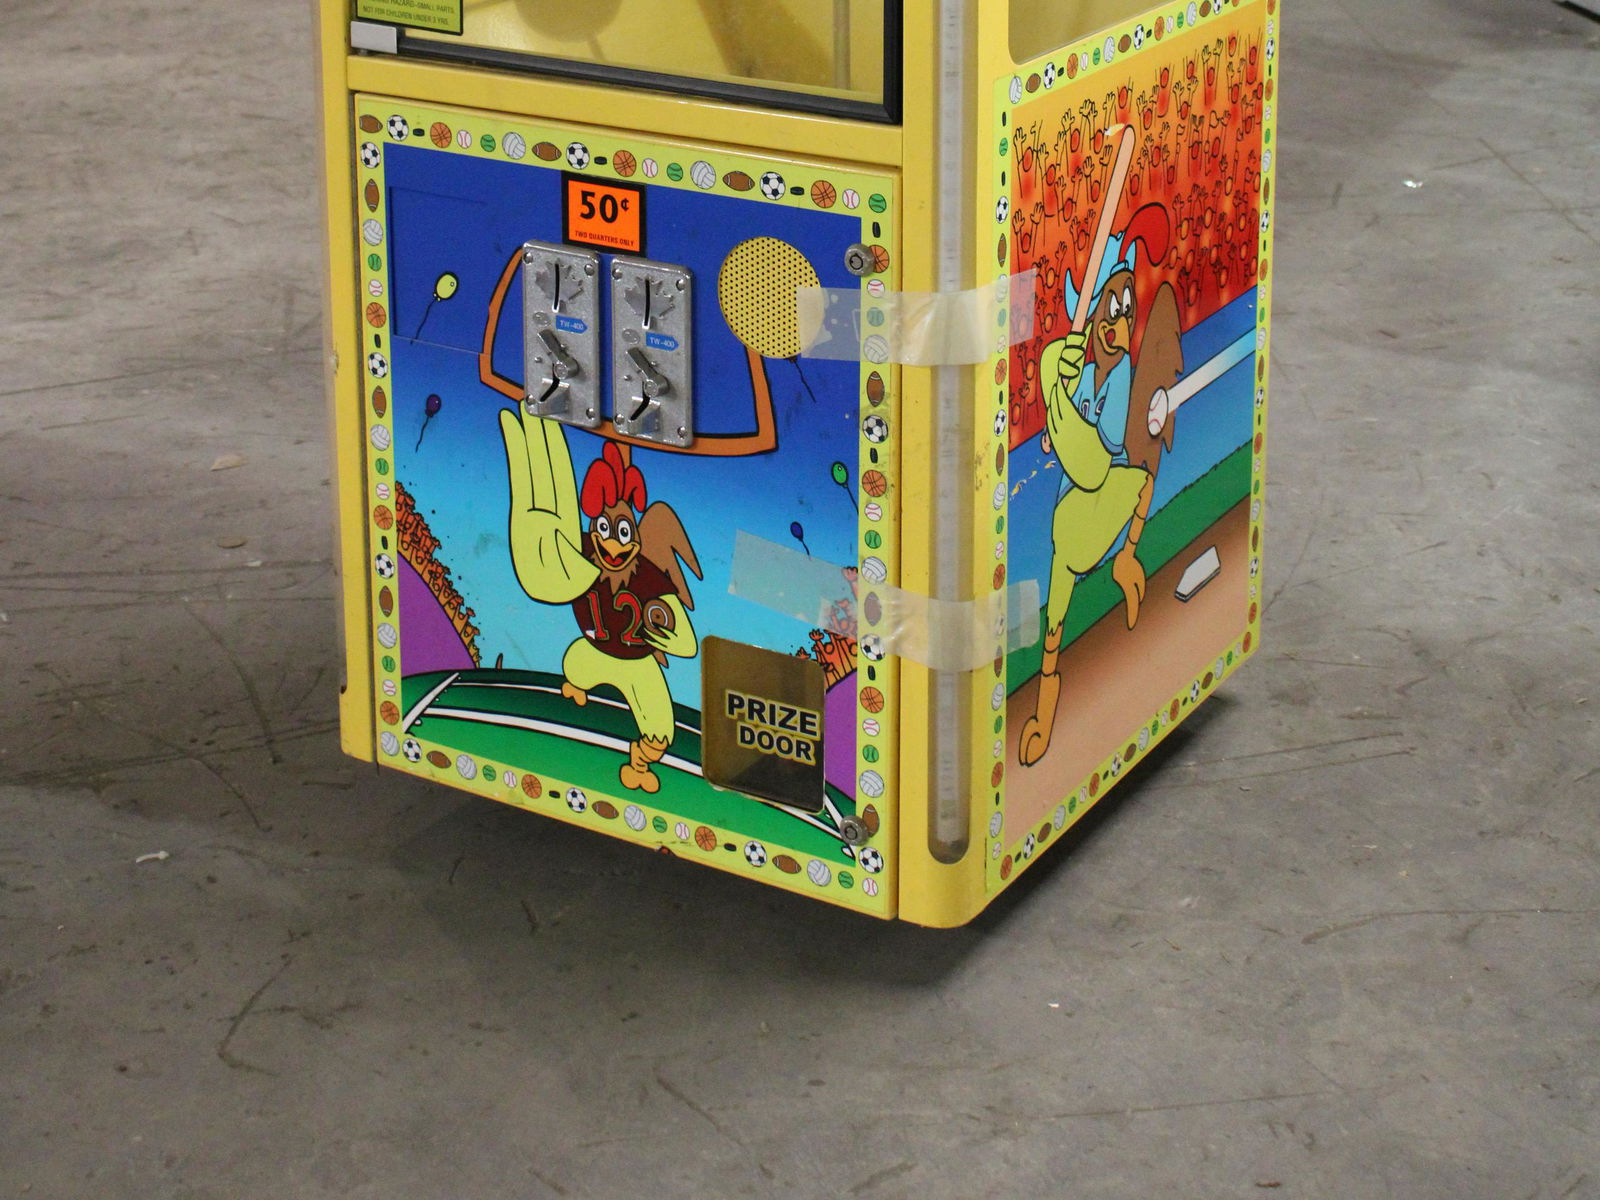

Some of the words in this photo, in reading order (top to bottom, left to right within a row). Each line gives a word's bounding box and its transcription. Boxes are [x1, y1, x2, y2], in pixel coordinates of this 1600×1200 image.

[363, 5, 374, 13] NOT
[374, 7, 386, 16] FOR
[386, 8, 413, 20] CHILDREN
[413, 13, 432, 23] UNDER
[580, 190, 629, 223] 50¢
[575, 230, 588, 238] TWO
[588, 233, 619, 244] QUARTERS
[619, 238, 634, 247] ONLY
[586, 590, 646, 645] 12
[727, 691, 818, 737] PRIZE
[739, 724, 813, 762] DOOR
